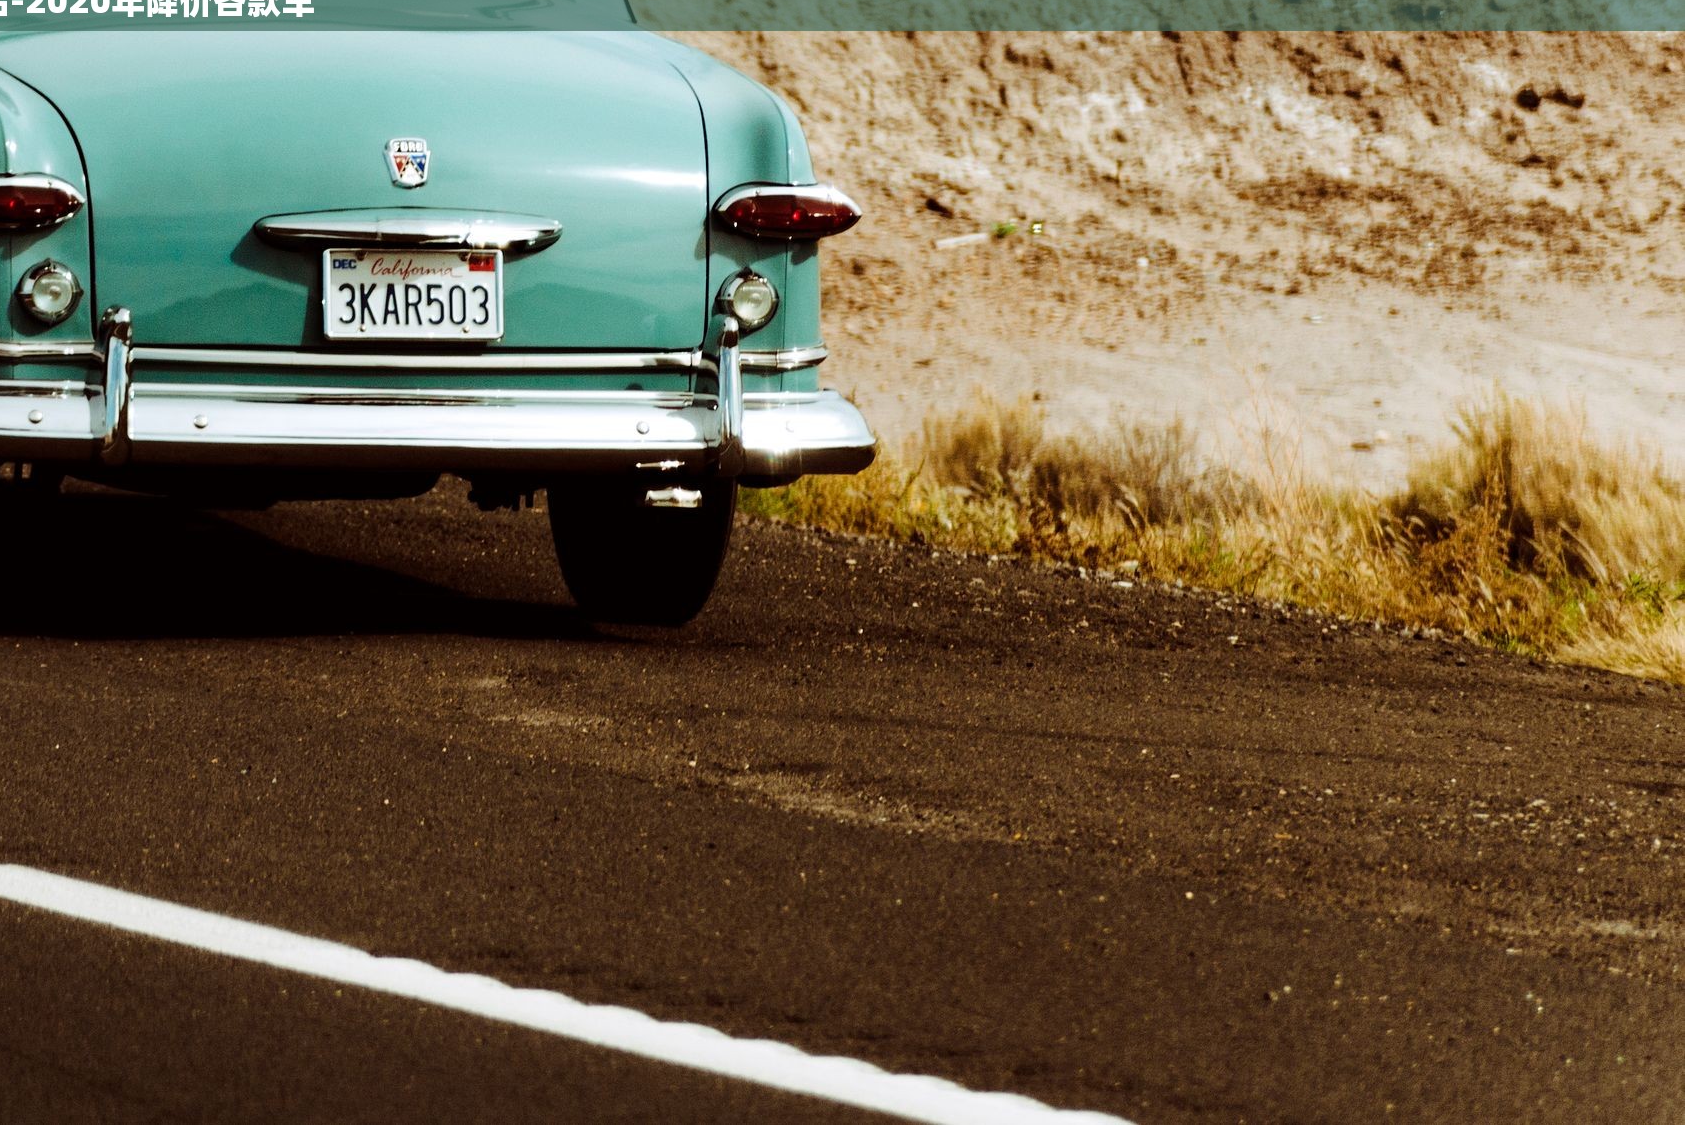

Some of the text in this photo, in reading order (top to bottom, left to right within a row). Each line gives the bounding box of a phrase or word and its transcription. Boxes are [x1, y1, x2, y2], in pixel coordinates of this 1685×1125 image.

[393, 141, 424, 152] FORD
[333, 259, 357, 269] DEC
[371, 257, 463, 280] California
[338, 283, 489, 325] 3KAR503
